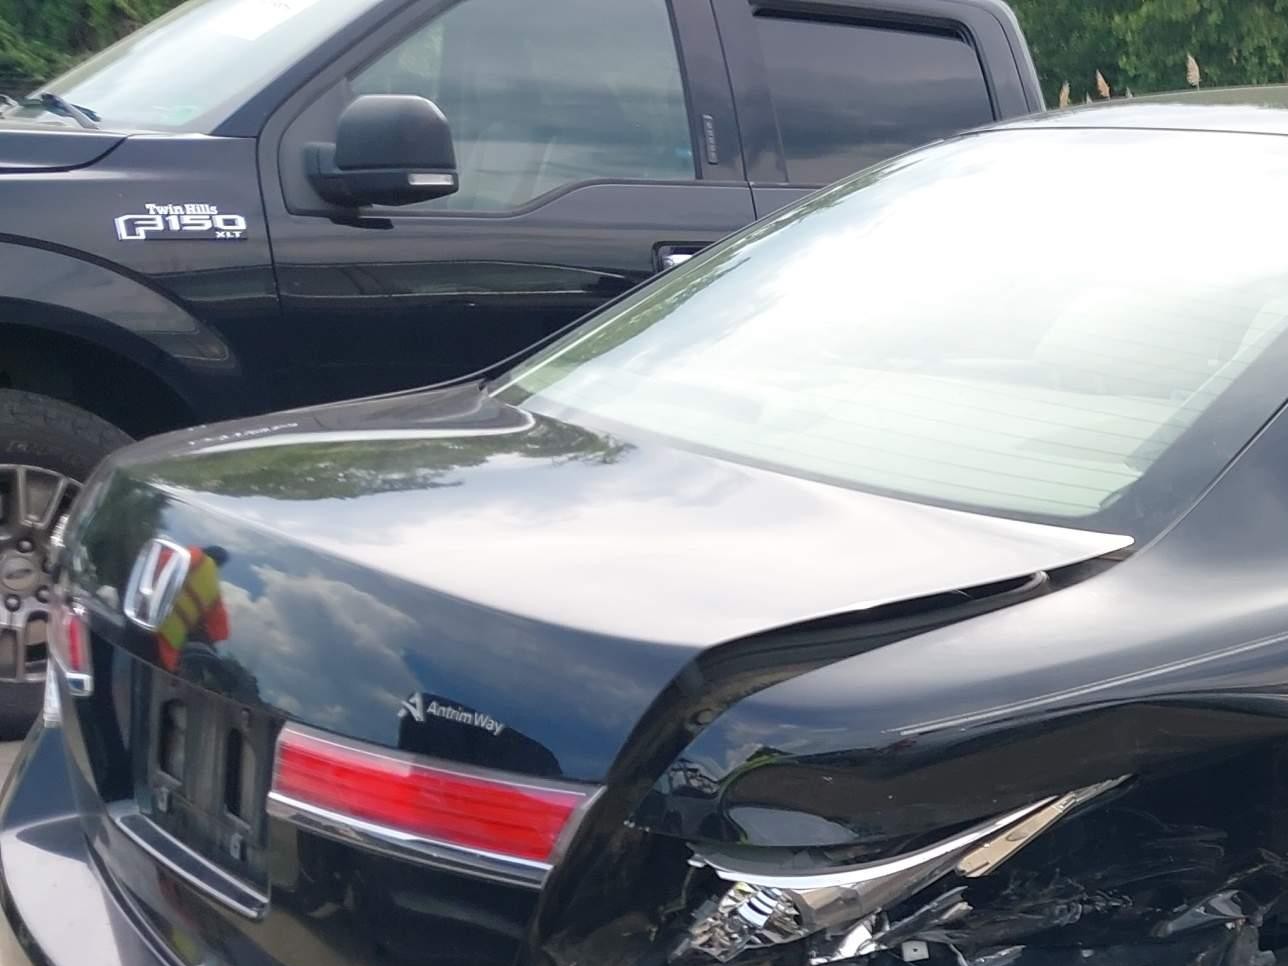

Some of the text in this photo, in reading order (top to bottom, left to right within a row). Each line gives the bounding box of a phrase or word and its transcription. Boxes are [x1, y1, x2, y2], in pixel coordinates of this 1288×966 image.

[144, 203, 218, 215] Twin Hills
[114, 214, 247, 240] F150
[215, 231, 242, 239] XLT
